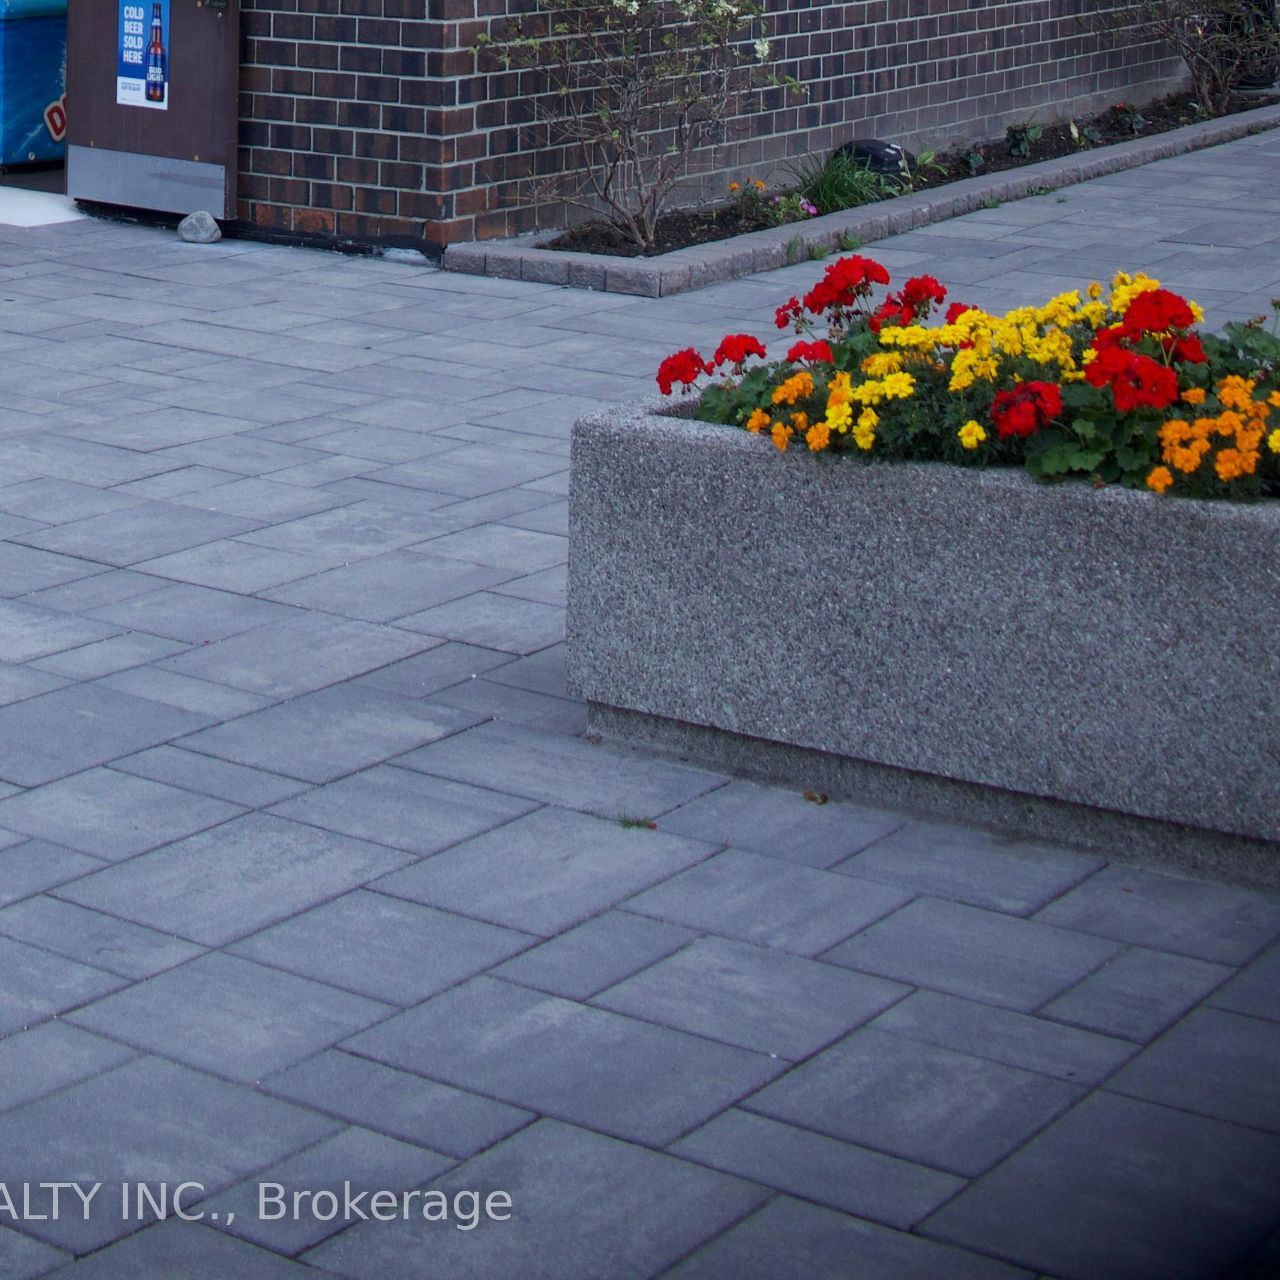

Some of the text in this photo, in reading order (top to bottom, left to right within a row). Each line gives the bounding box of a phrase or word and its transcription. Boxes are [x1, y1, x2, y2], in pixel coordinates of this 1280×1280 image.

[124, 6, 144, 19] COLD
[124, 21, 144, 34] BEER
[123, 35, 143, 49] SOLD
[123, 49, 143, 64] HERE
[149, 66, 162, 74] BUD
[147, 73, 163, 81] LIGHT
